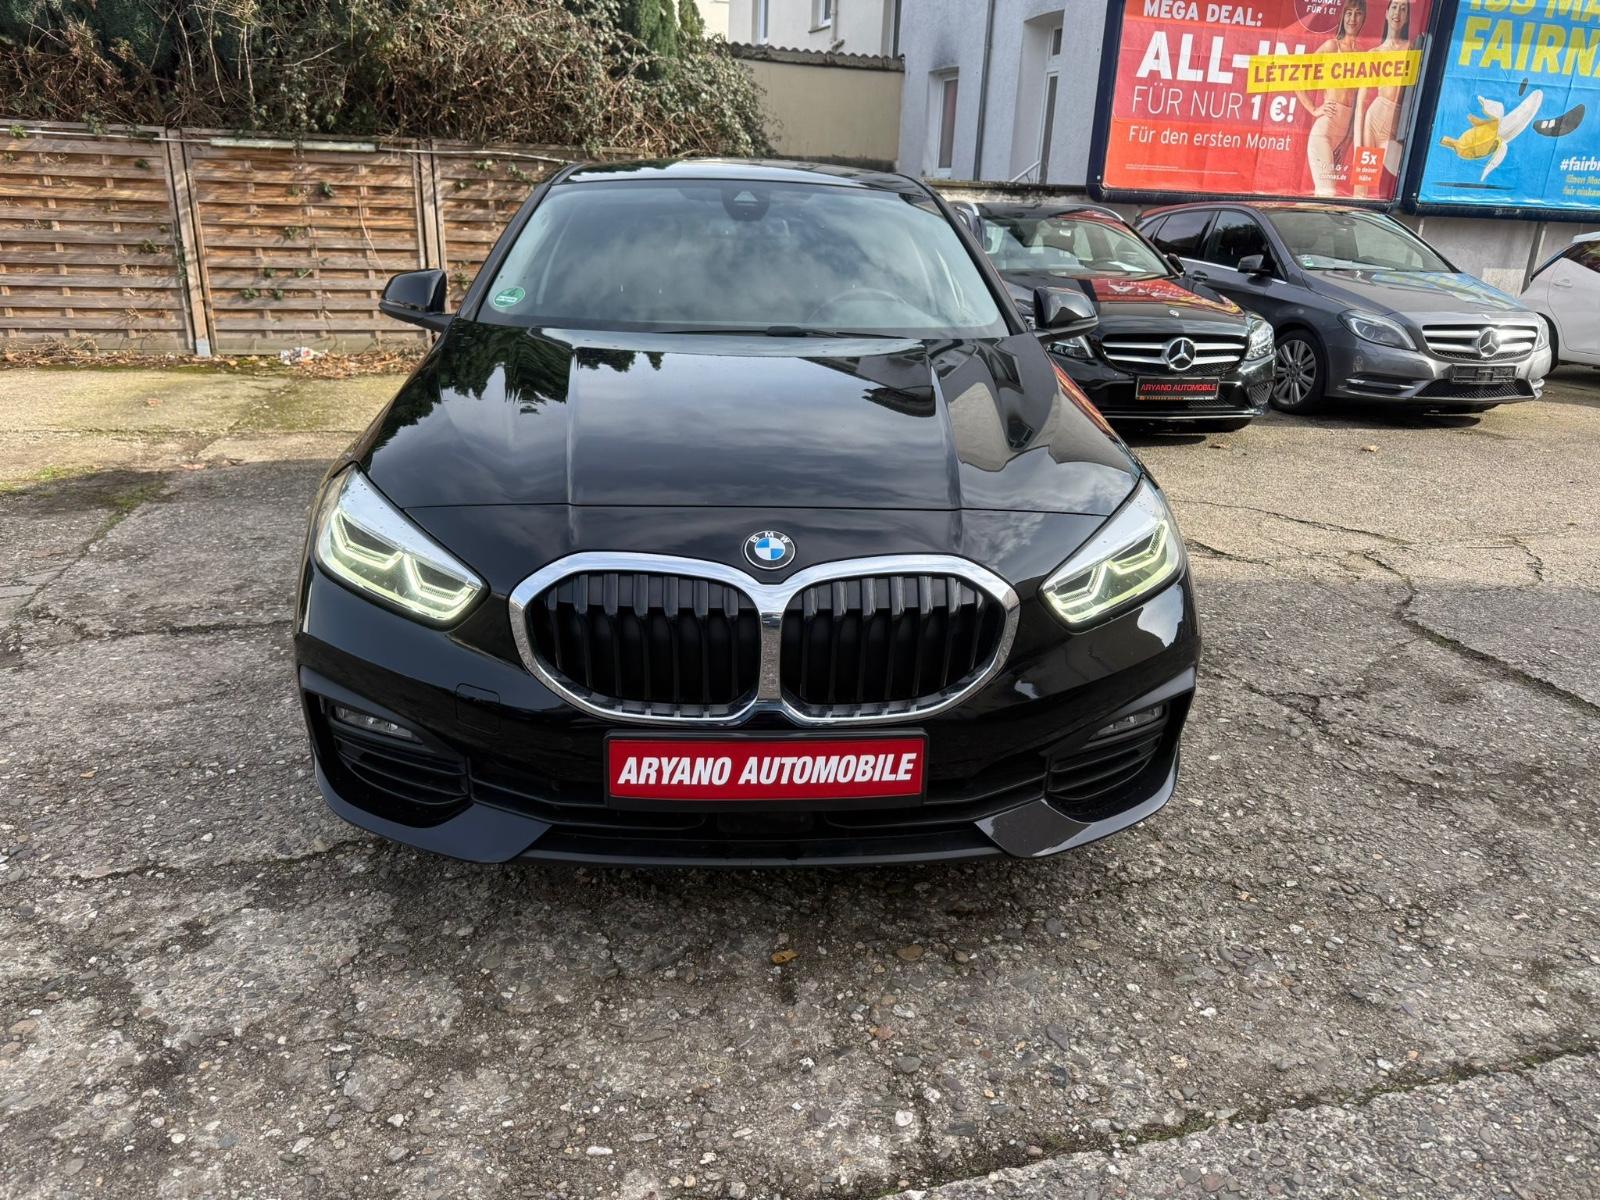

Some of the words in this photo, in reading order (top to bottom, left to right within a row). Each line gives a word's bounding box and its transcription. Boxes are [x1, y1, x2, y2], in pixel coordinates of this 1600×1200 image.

[1143, 0, 1199, 21] MEGA
[1206, 3, 1264, 27] DEAL:
[1306, 4, 1322, 14] FÜR
[1136, 31, 1306, 84] ALL-
[1458, 15, 1600, 78] FAIRN
[1254, 63, 1325, 83] LETZTE
[1331, 60, 1410, 80] CHANCE!
[1132, 81, 1183, 116] FÜR
[1190, 89, 1244, 120] NUR
[1251, 94, 1262, 121] 1
[1269, 95, 1297, 123] €!
[1129, 125, 1157, 144] Für
[1160, 128, 1188, 145] den
[1193, 130, 1241, 148] ersten
[1246, 132, 1292, 151] Monat
[1360, 151, 1377, 165] 5x
[1140, 383, 1172, 391] ARYANO
[1172, 383, 1217, 391] AUTOMOBILE
[749, 530, 791, 543] BMW
[617, 756, 732, 785] ARYANO
[738, 752, 917, 785] AUTOMOBILE
